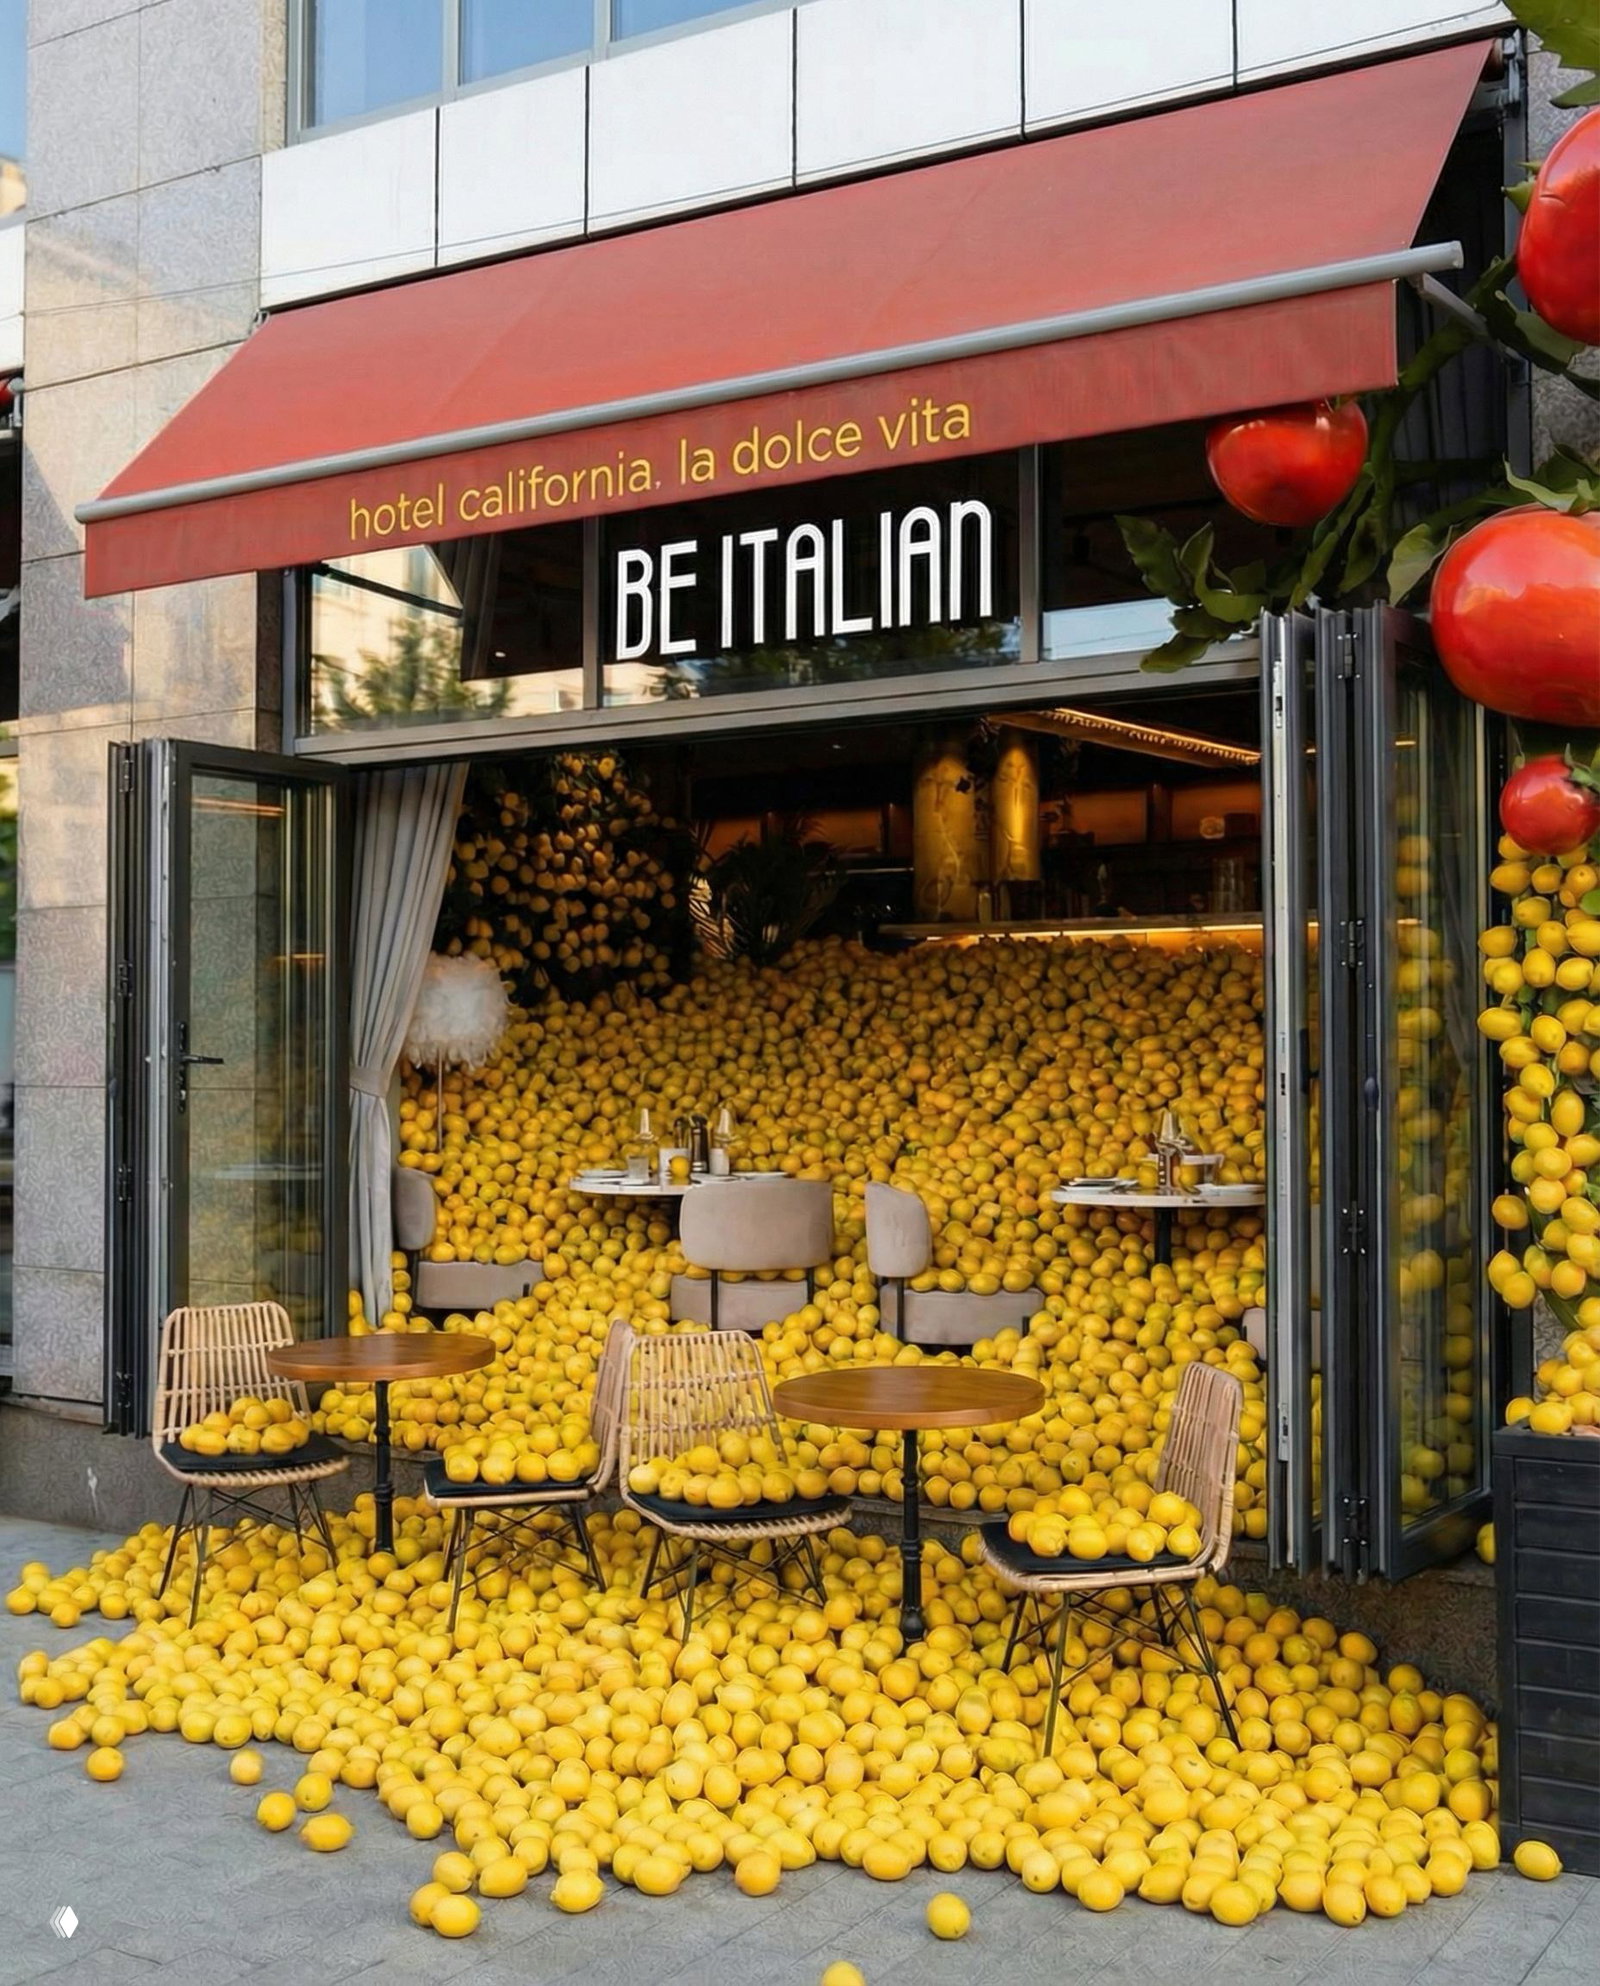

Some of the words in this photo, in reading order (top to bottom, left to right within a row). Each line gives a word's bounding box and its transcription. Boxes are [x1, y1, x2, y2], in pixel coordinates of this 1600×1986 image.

[350, 482, 444, 541] hotel
[680, 437, 716, 485] la
[732, 419, 863, 475] dolce
[877, 397, 971, 449] vita
[616, 540, 698, 661] BE
[721, 500, 992, 648] ITALIAN
